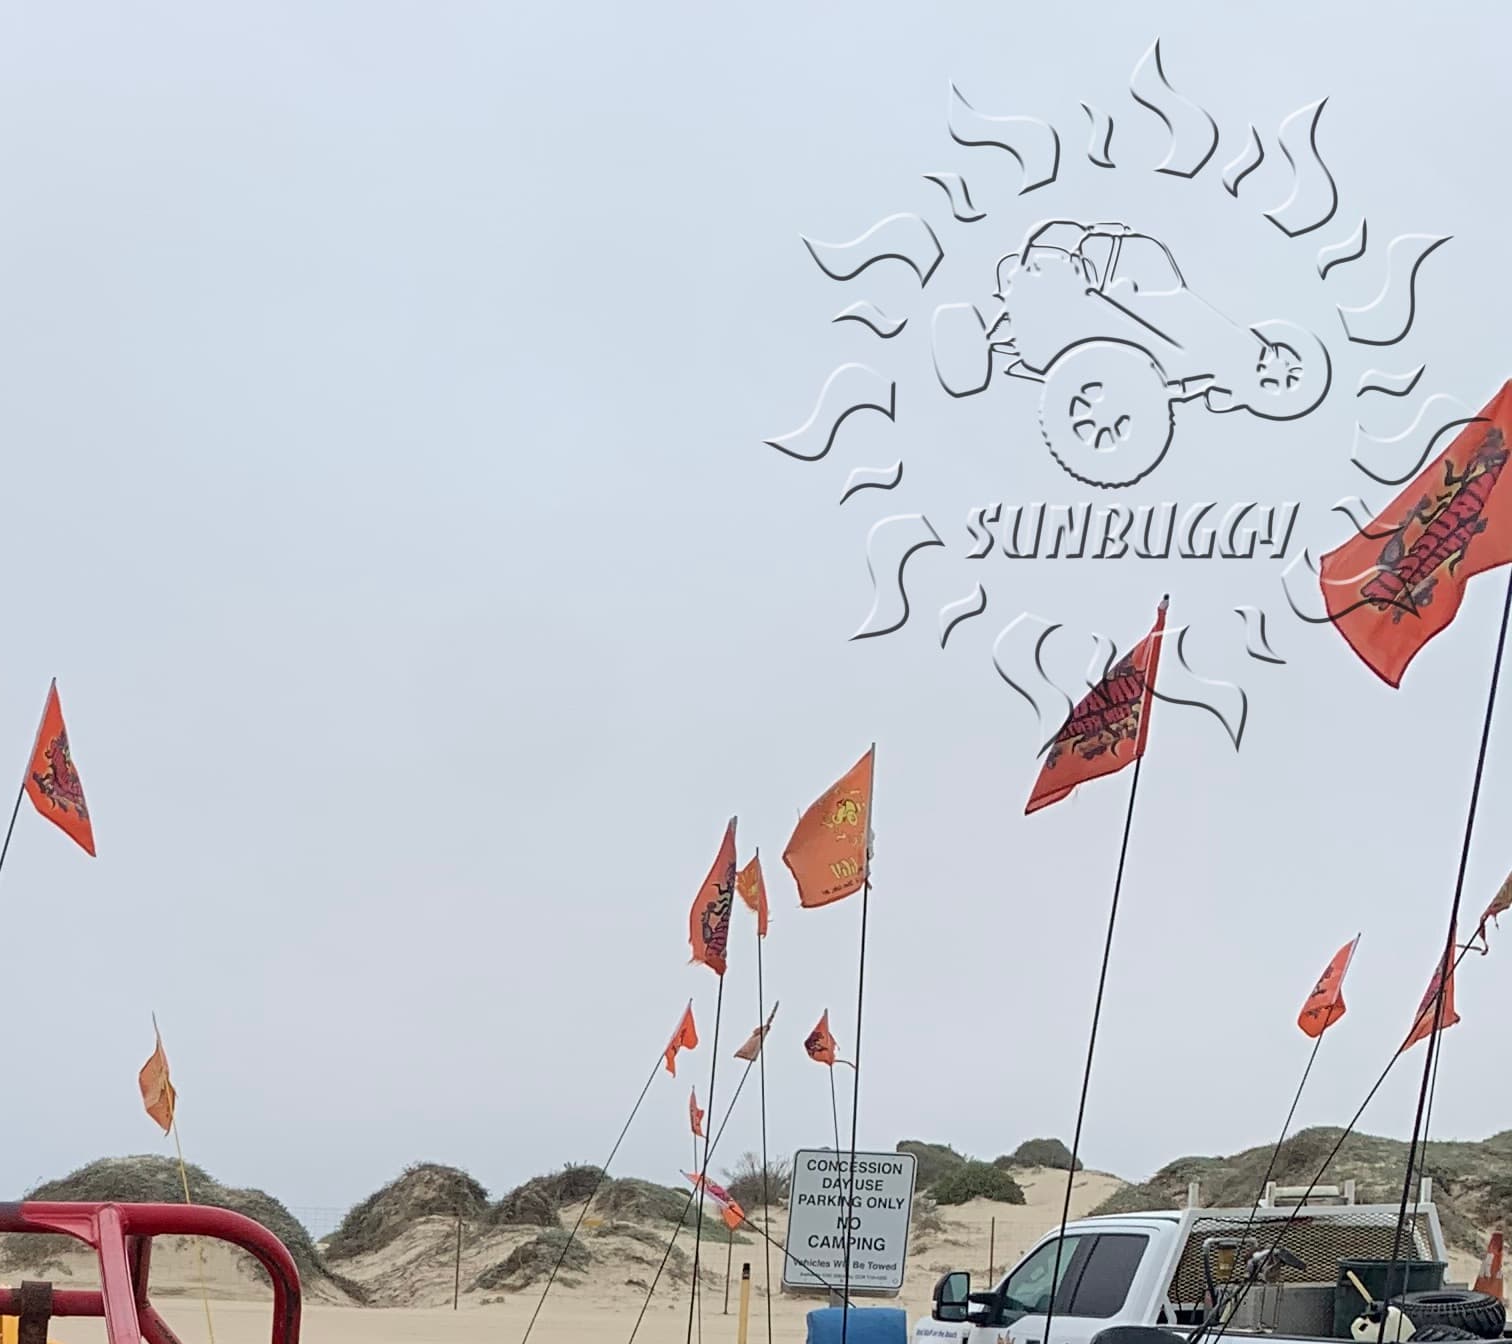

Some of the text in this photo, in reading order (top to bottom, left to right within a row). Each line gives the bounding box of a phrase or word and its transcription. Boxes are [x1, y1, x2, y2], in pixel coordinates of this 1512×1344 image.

[806, 1159, 903, 1175] CONCESSION
[822, 1177, 884, 1191] DAY USE
[798, 1193, 905, 1210] PARKING ONLY
[836, 1216, 862, 1230] NO
[807, 1234, 886, 1252] CAMPING
[833, 1260, 849, 1269] Wi
[852, 1261, 865, 1270] Be
[867, 1261, 897, 1271] Towed
